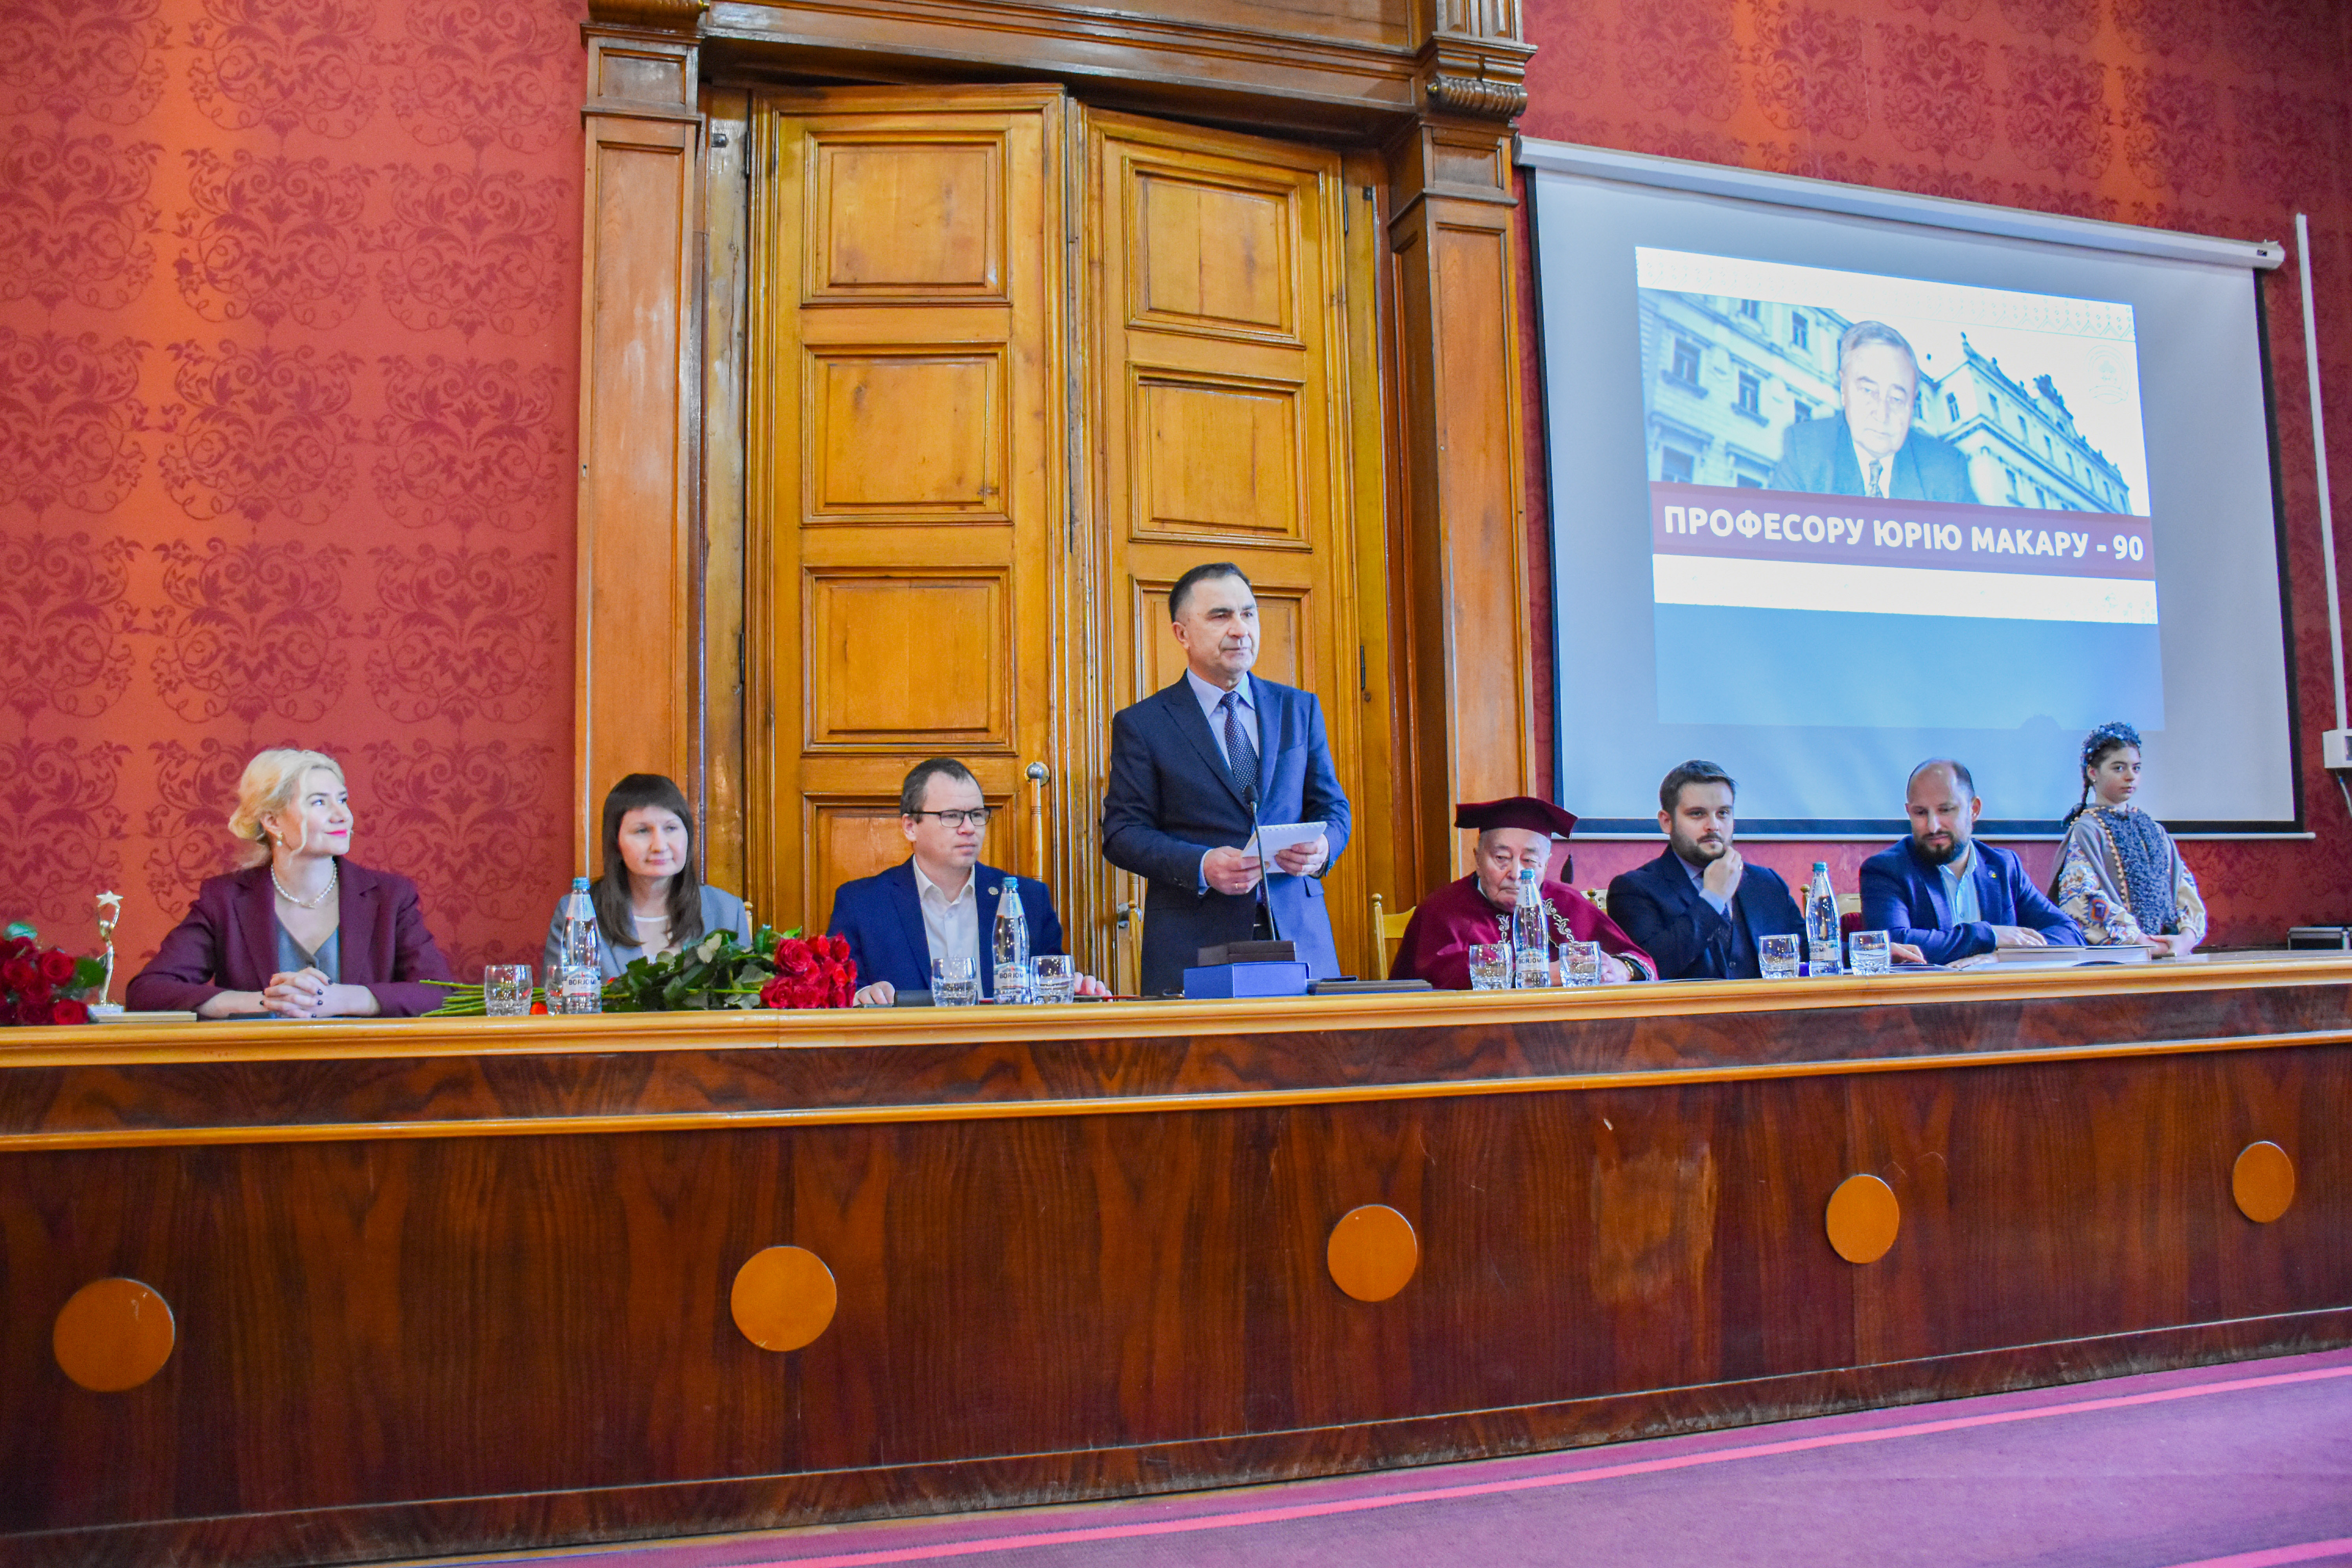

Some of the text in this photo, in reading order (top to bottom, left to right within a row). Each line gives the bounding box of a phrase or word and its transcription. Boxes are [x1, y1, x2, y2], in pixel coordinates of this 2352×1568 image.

[1664, 506, 1864, 544] ПРОФЕСОРУ
[1873, 520, 1962, 550] ЮРІЮ
[1971, 526, 2088, 557] МАКАРУ
[2113, 535, 2143, 561] 90
